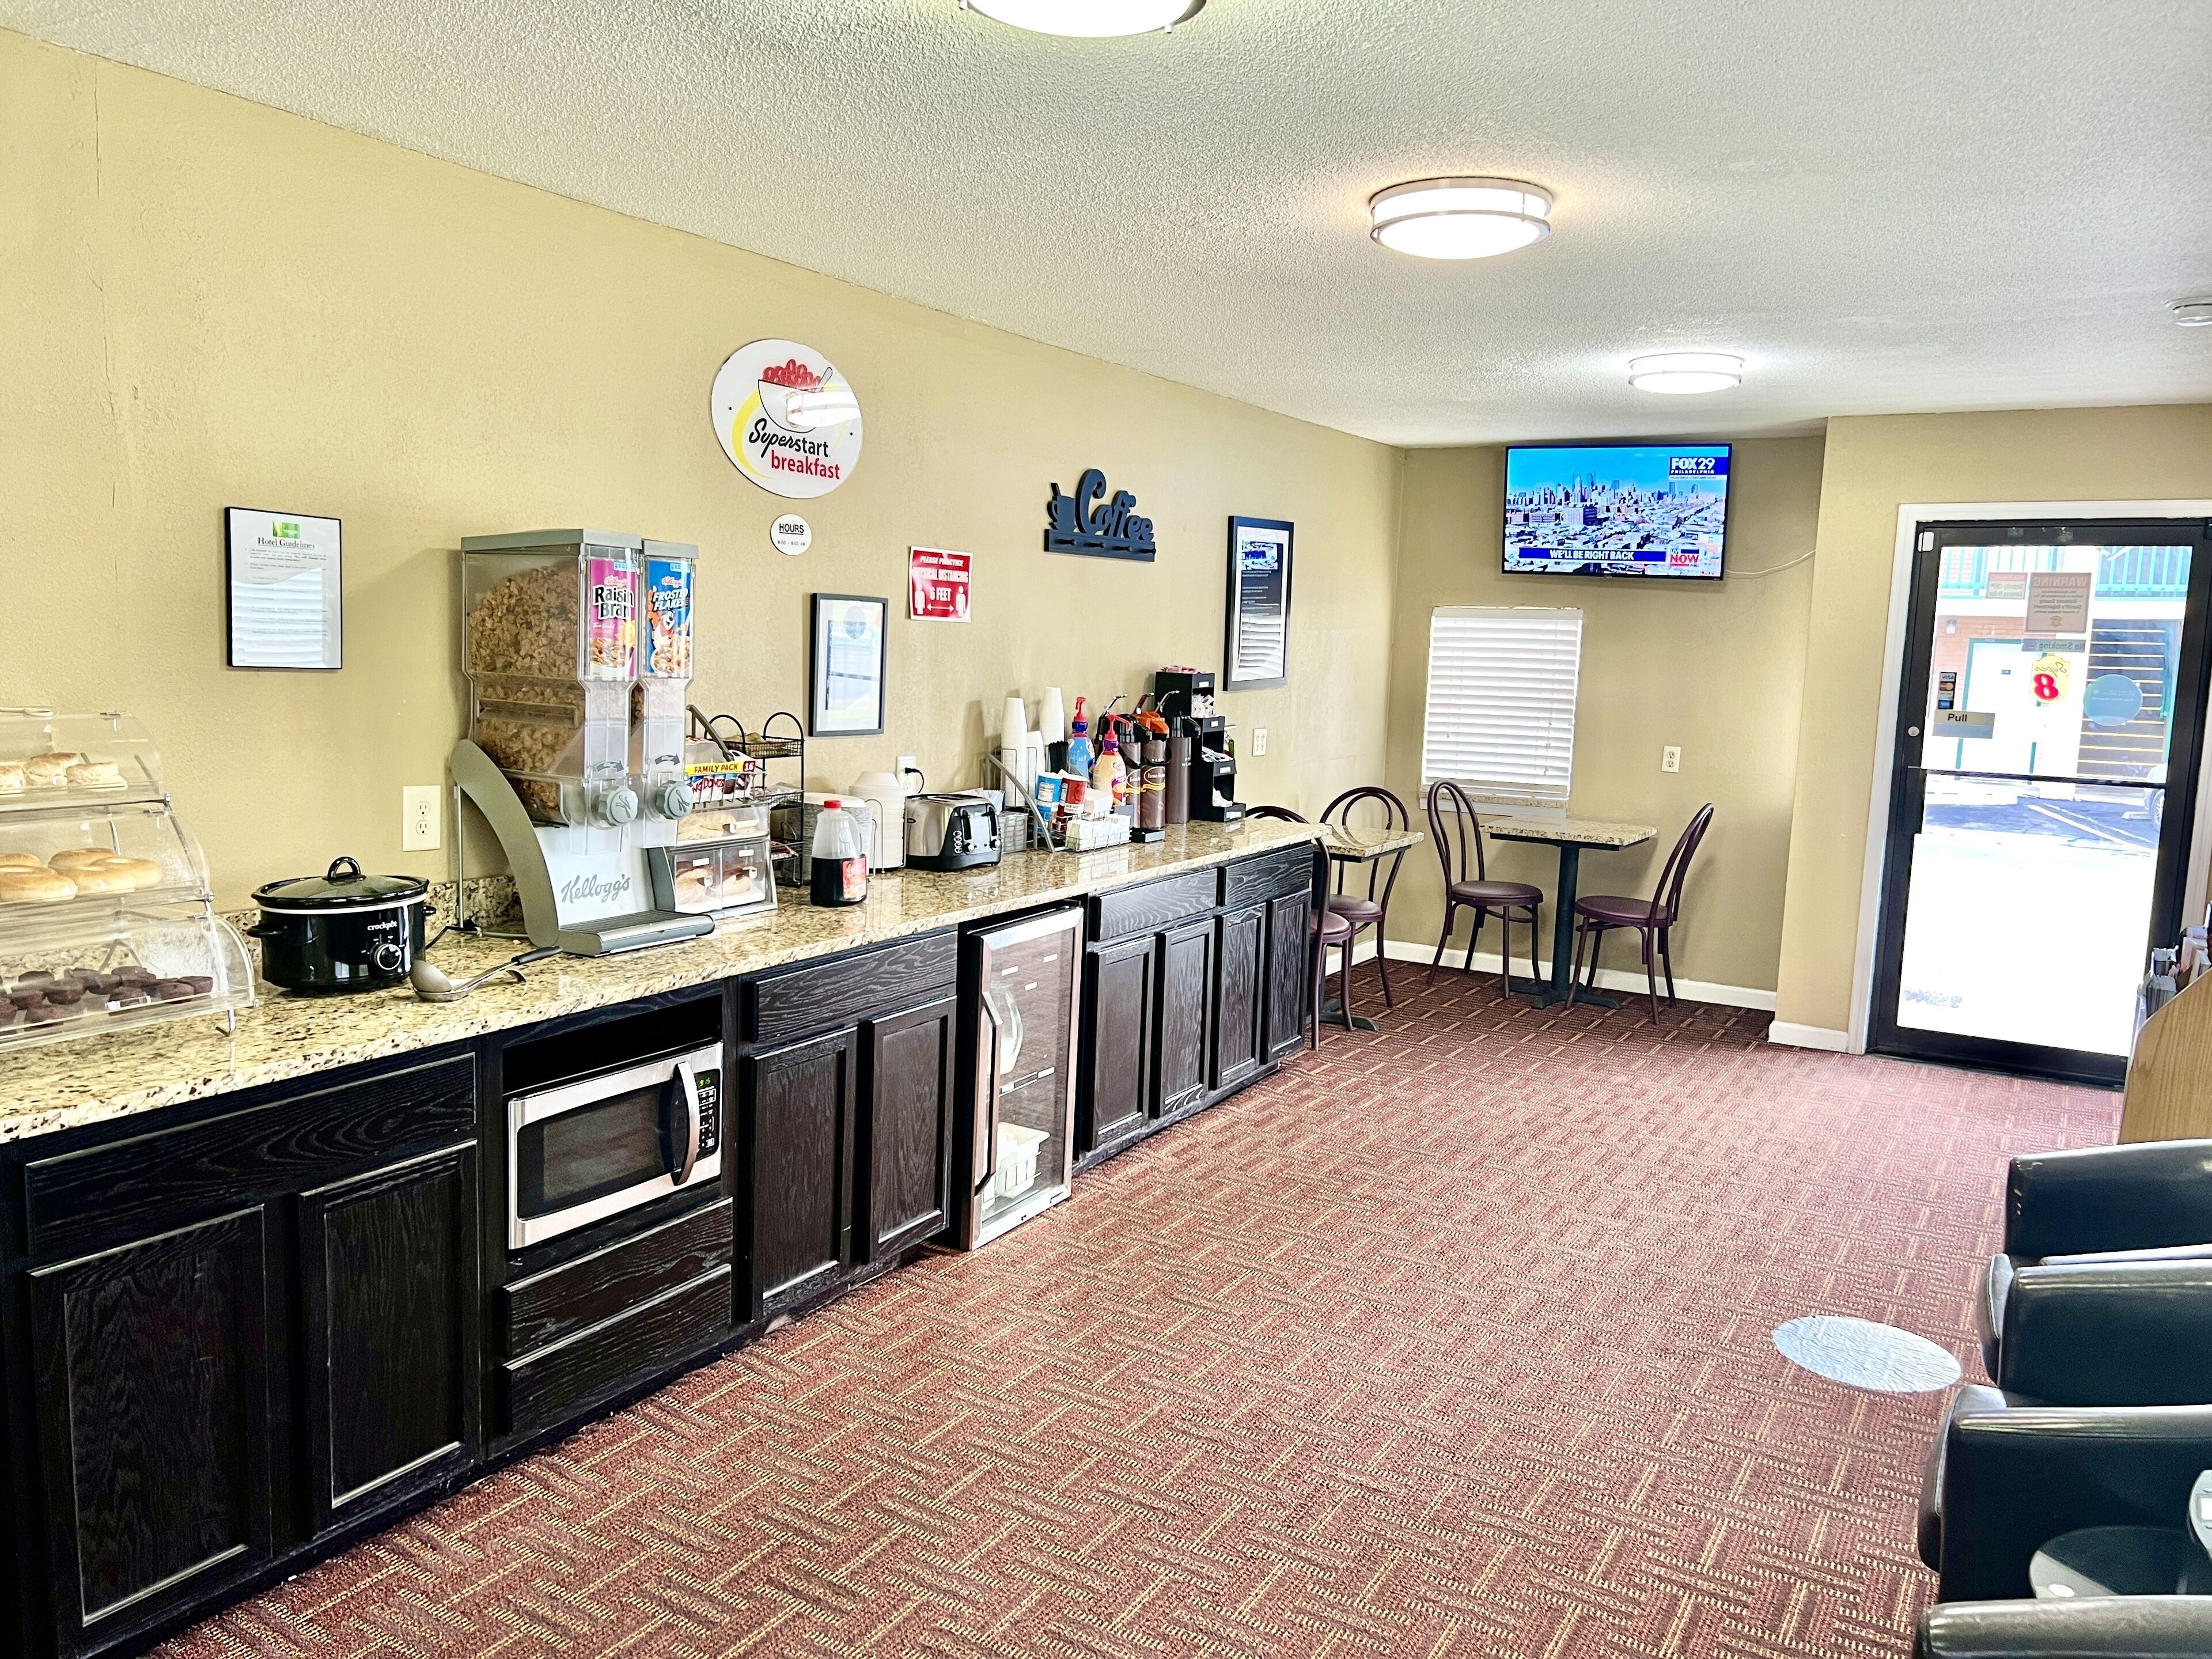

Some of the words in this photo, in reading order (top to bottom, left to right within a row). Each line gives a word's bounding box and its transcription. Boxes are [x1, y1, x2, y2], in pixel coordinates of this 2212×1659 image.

[749, 418, 828, 458] Superstart
[771, 450, 840, 479] breakfast
[1075, 469, 1154, 541] Coffee
[779, 523, 804, 533] HOURS
[257, 537, 278, 546] Hotel
[279, 539, 316, 549] Guidelines
[920, 556, 939, 564] PLEASE
[939, 558, 964, 566] PRACTICE
[1550, 549, 1572, 559] WE'LL
[1573, 550, 1584, 559] BE
[1584, 550, 1609, 559] RIGHT
[1610, 551, 1634, 560] BACK
[1671, 554, 1699, 563] NOW
[593, 585, 634, 608] Raisin
[652, 588, 688, 603] FROSTED
[930, 586, 935, 600] 6
[936, 587, 952, 601] FEET
[600, 602, 631, 619] Bran
[653, 597, 687, 611] FLAKES
[1948, 713, 1967, 722] Pull
[694, 764, 718, 774] FAMILY
[721, 763, 738, 771] PACK
[561, 874, 630, 904] Kellogg's
